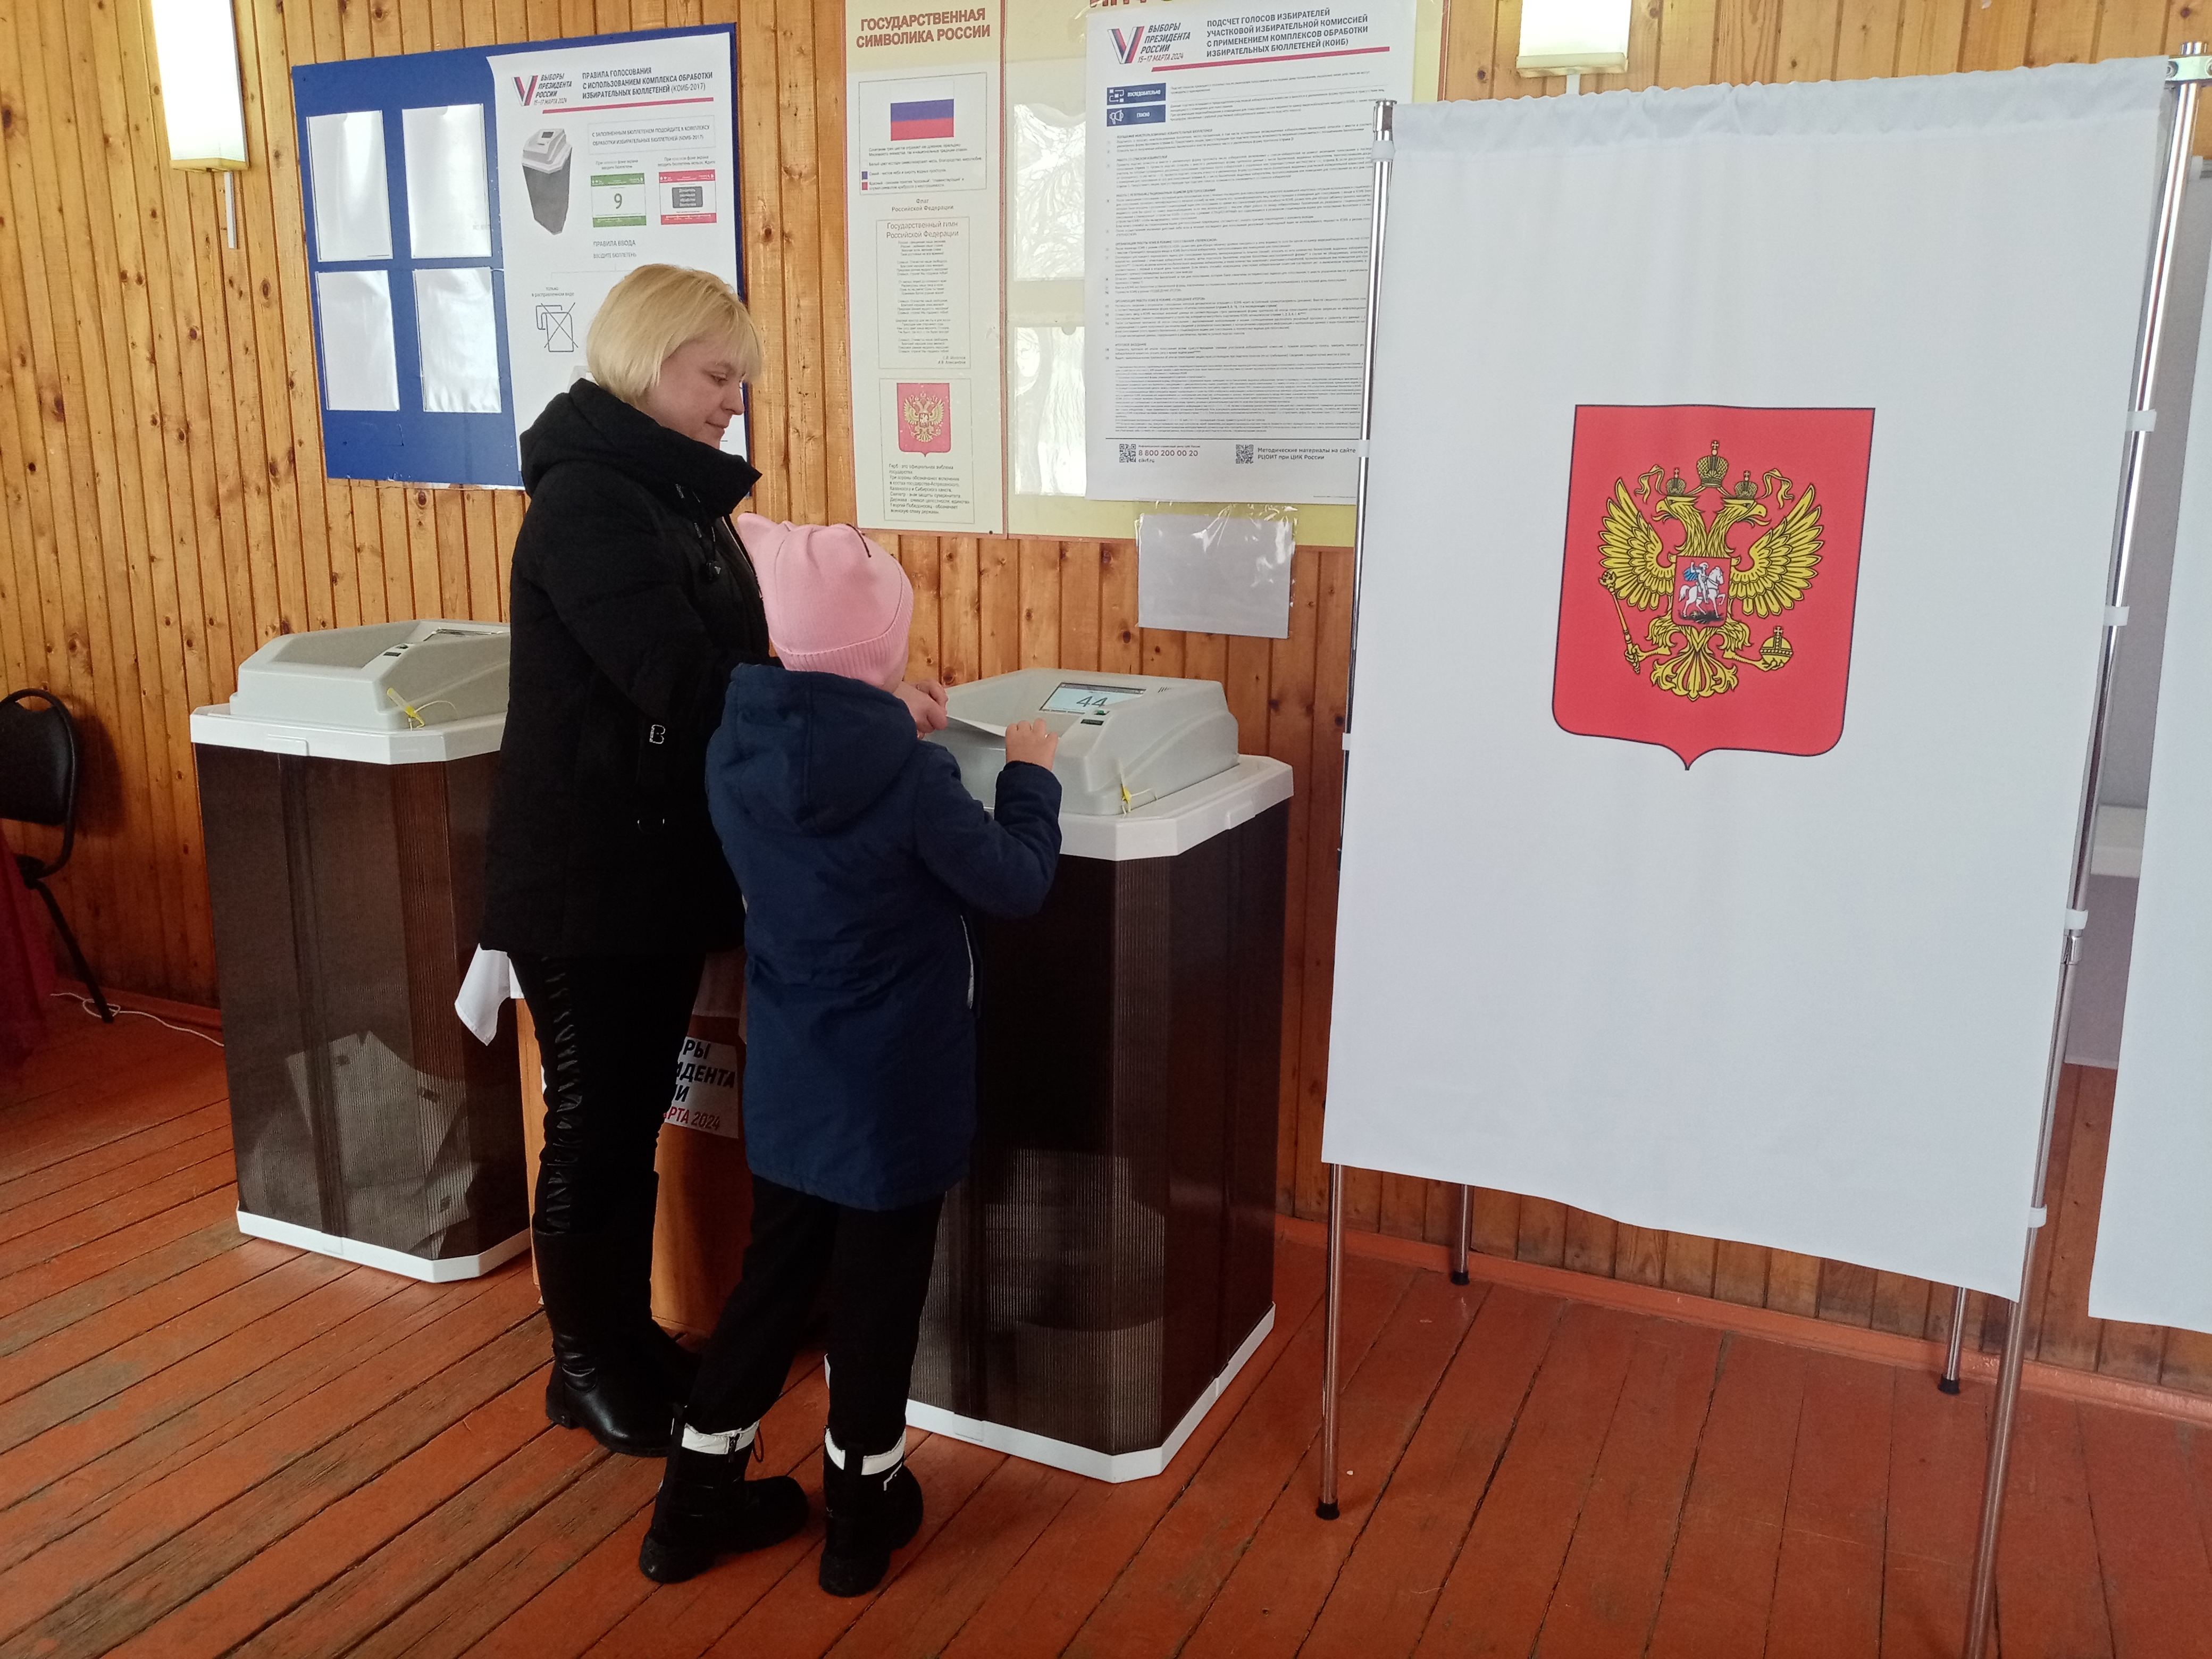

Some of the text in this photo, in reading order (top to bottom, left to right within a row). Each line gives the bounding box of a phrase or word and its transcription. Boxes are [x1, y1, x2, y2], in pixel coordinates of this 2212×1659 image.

[861, 8, 985, 31] ГОСУДАРСТВЕННАЯ
[1207, 7, 1330, 27] ПОДСЧЕТ ГОЛОСОВ ИЗБИРАТЕЛЕЙ
[1148, 22, 1181, 33] ВЫБОРЫ
[1207, 14, 1368, 37] УЧАСТКОВОЙ ИЗБИРАТЕЛЬНОЙ КОМИССИЕЙ
[856, 24, 990, 48] СИМВОЛИКА РОССИИ
[1144, 32, 1191, 44] ПРЕЗИДЕНТА
[1213, 35, 1269, 47] ПРИМЕНЕНИЕМ
[1270, 30, 1321, 41] КОМПЛЕКСОВ
[1323, 26, 1368, 37] ОБРАБОТКИ
[1141, 44, 1170, 54] РОССИИ
[1206, 38, 1348, 57] ИЗБИРАТЕЛЬНЫХ БЮЛЛЕТЕНЕЙ (КОИБ)
[1152, 53, 1170, 62] МАРТА
[610, 67, 651, 77] ГОЛОСОВАНИЯ
[539, 81, 572, 89] ПРЕЗИДЕНТА
[588, 78, 641, 89] ИСПОЛЬЗОВАНИЕМ
[642, 76, 677, 84] КОМПЛЕКСА
[678, 72, 713, 81] ОБРАБОТКИ
[582, 82, 706, 99] ИЗБИРАТЕЛЬНЫХ БЮЛЛЕТЕНЕЙ (КОИБ-2017)
[614, 193, 623, 209] 9
[887, 221, 941, 230] Государственный
[1077, 696, 1108, 708] 44
[691, 1111, 720, 1130] 2024
